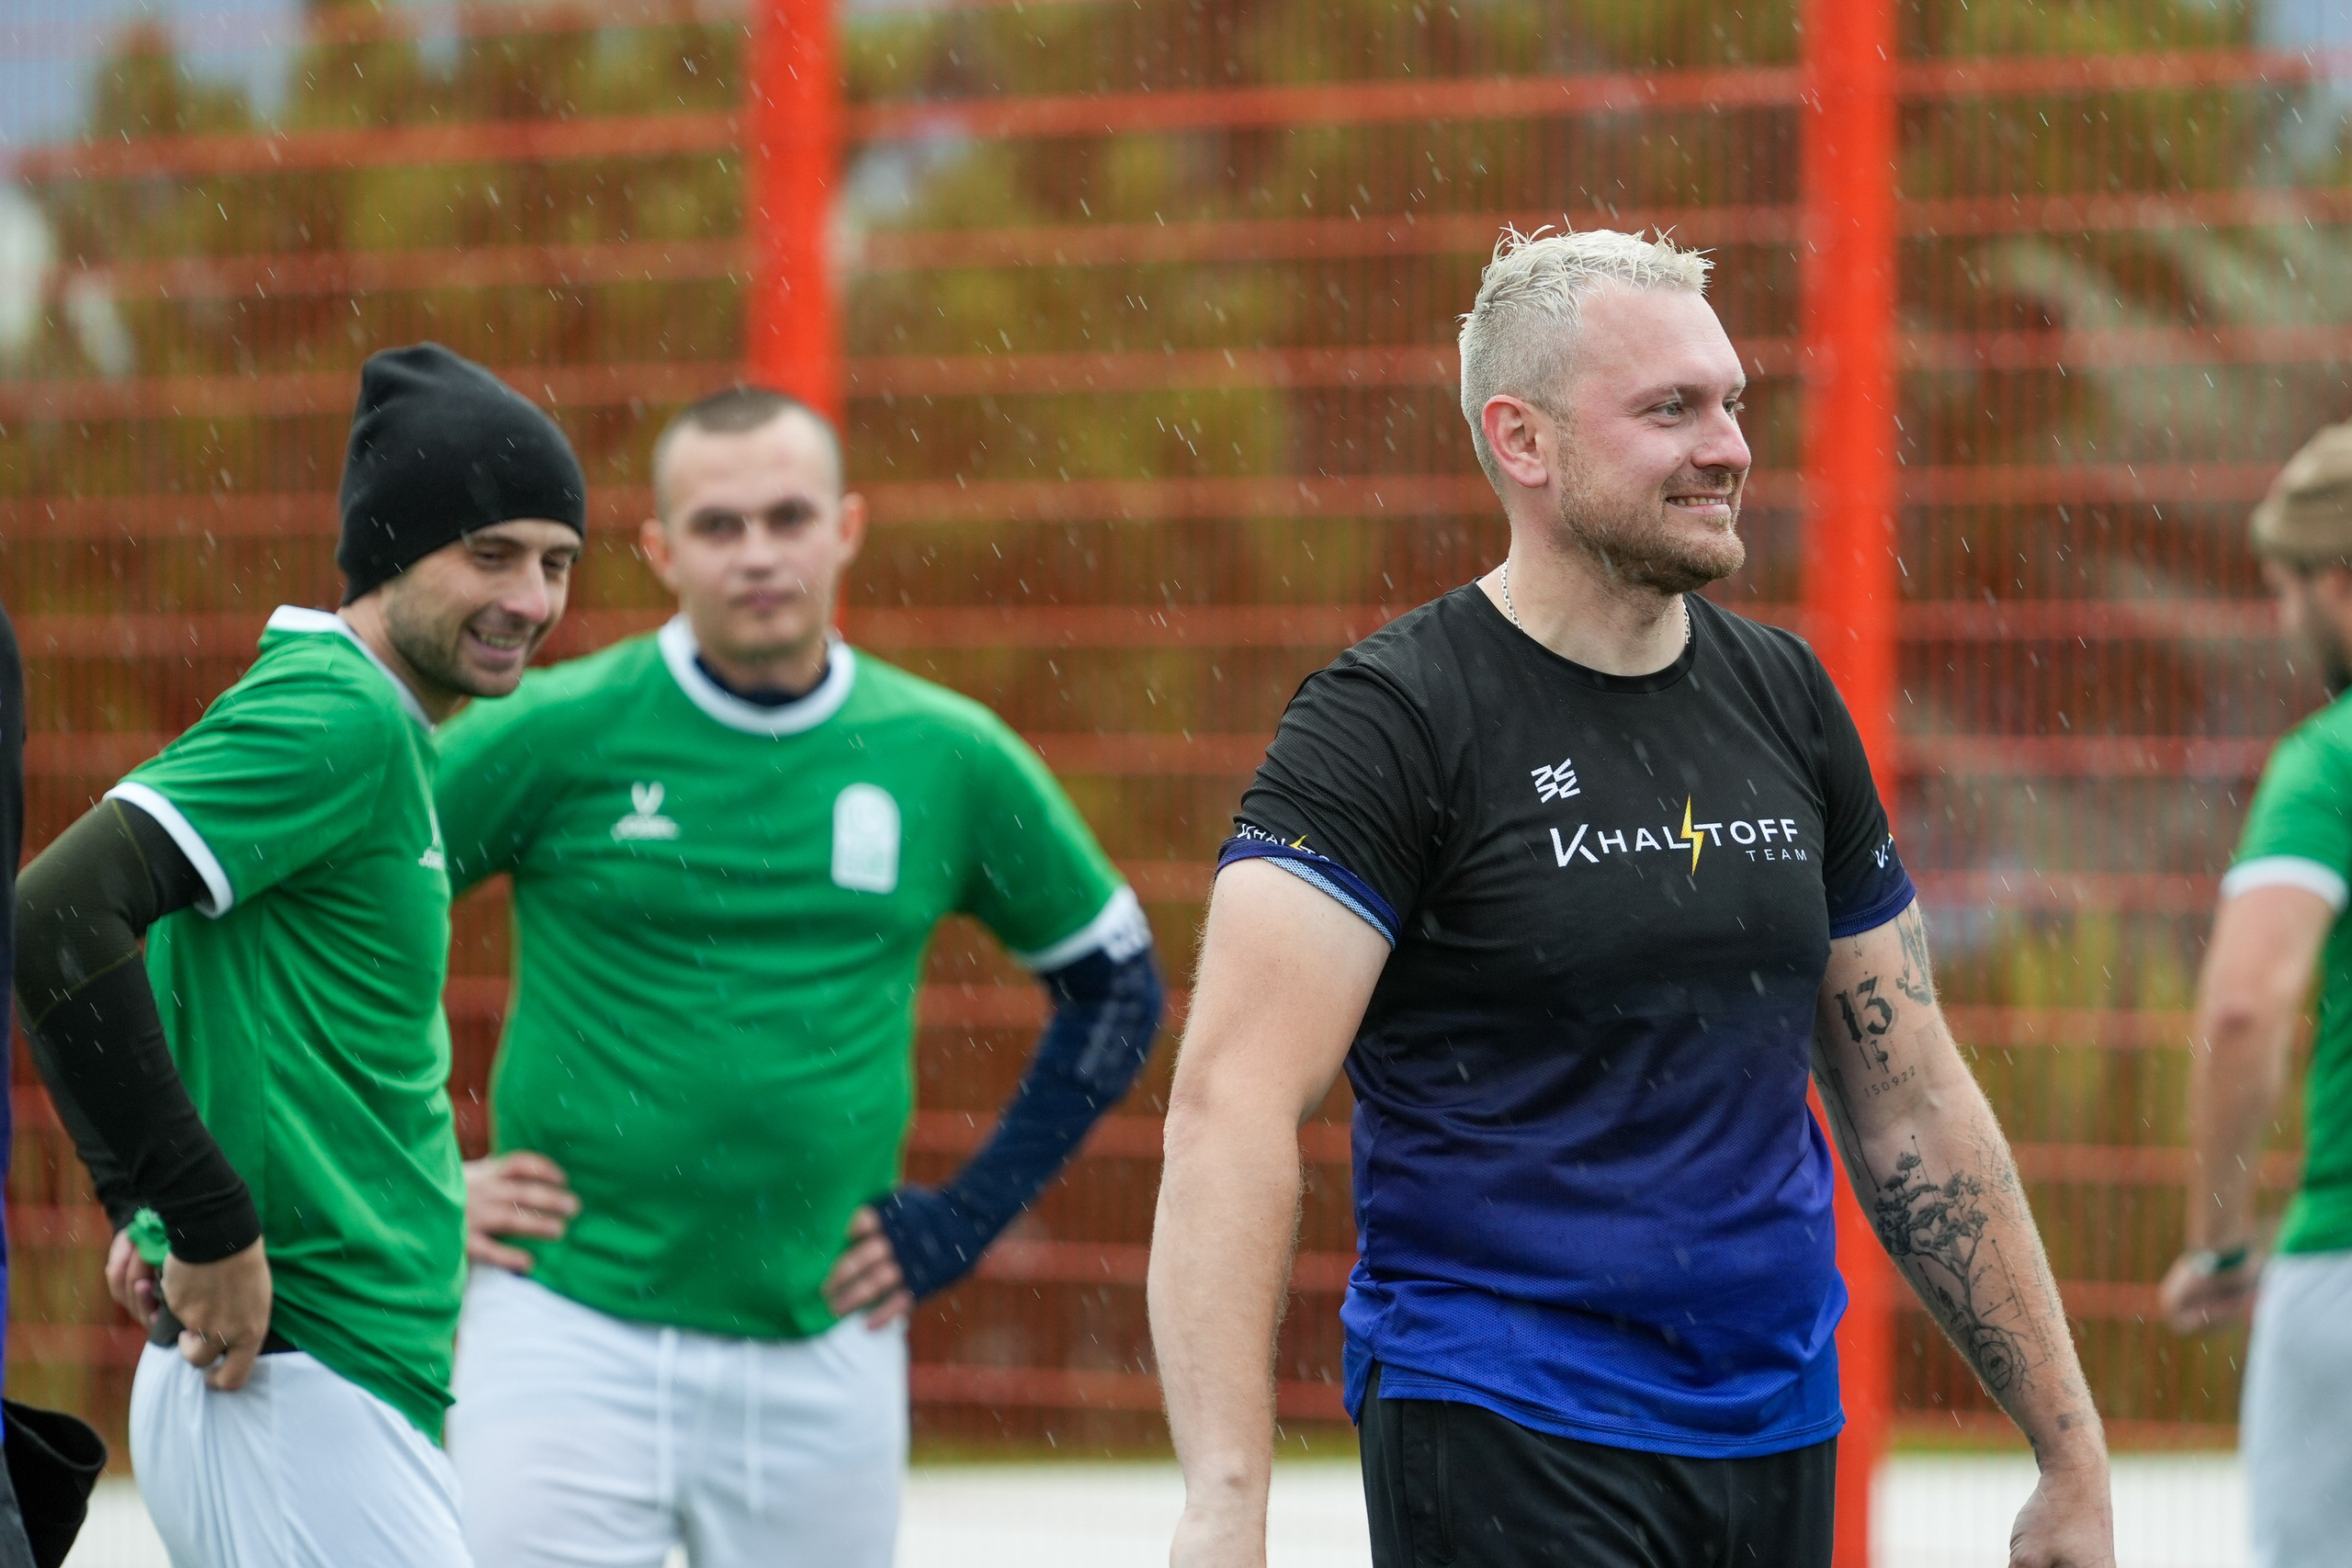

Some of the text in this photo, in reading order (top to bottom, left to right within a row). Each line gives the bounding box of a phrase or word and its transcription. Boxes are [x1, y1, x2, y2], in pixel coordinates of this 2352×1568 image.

[1745, 848, 1808, 862] TEAM
[1834, 976, 1893, 1043] 13
[1864, 1066, 1916, 1098] 150922
